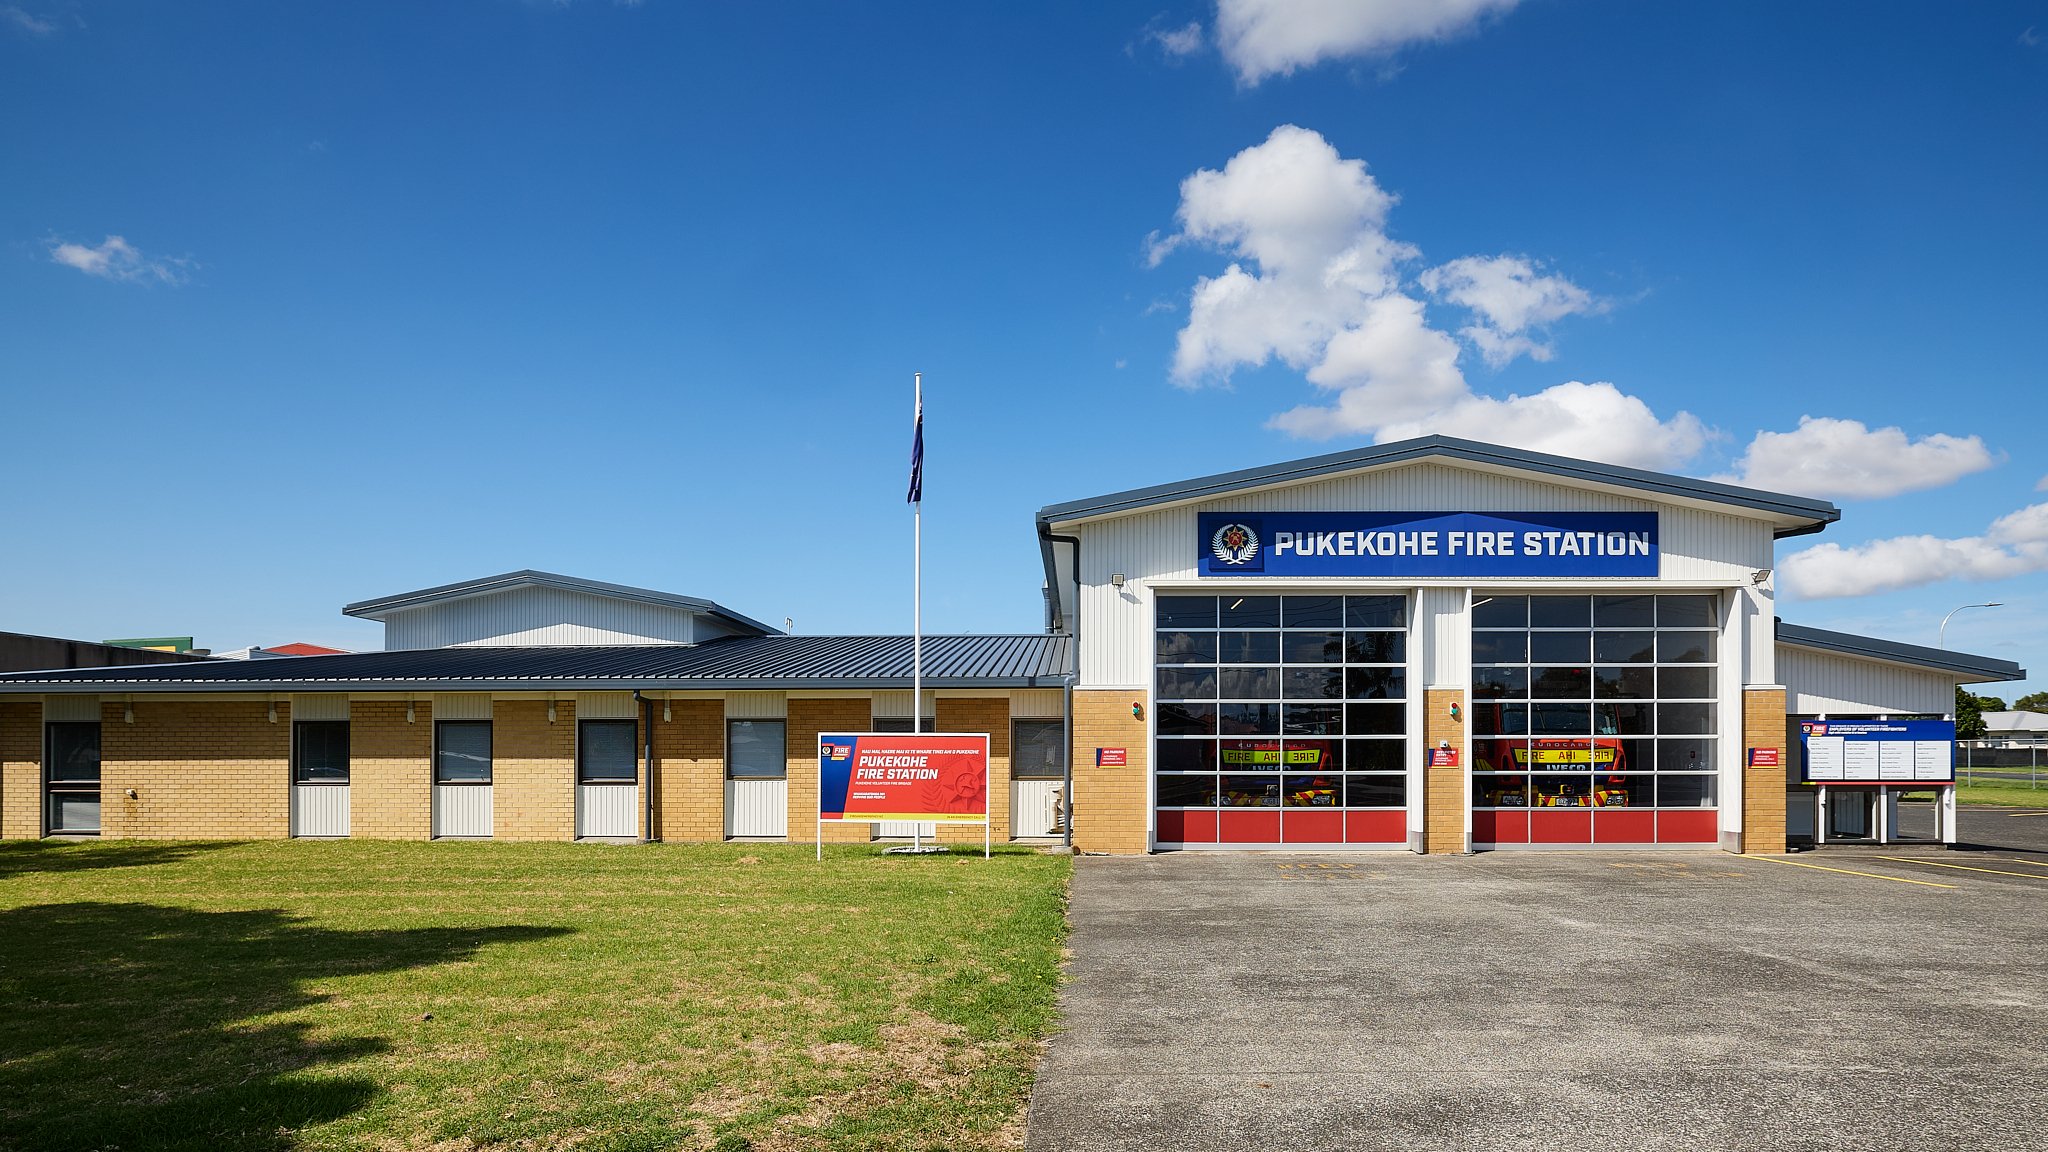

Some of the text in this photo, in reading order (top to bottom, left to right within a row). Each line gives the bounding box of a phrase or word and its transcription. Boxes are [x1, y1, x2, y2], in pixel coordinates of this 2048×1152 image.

[1275, 531, 1648, 556] PUKEKOHE FIRE STATION
[859, 756, 928, 767] PUKEKOHE
[856, 769, 938, 779] FIRE STATION
